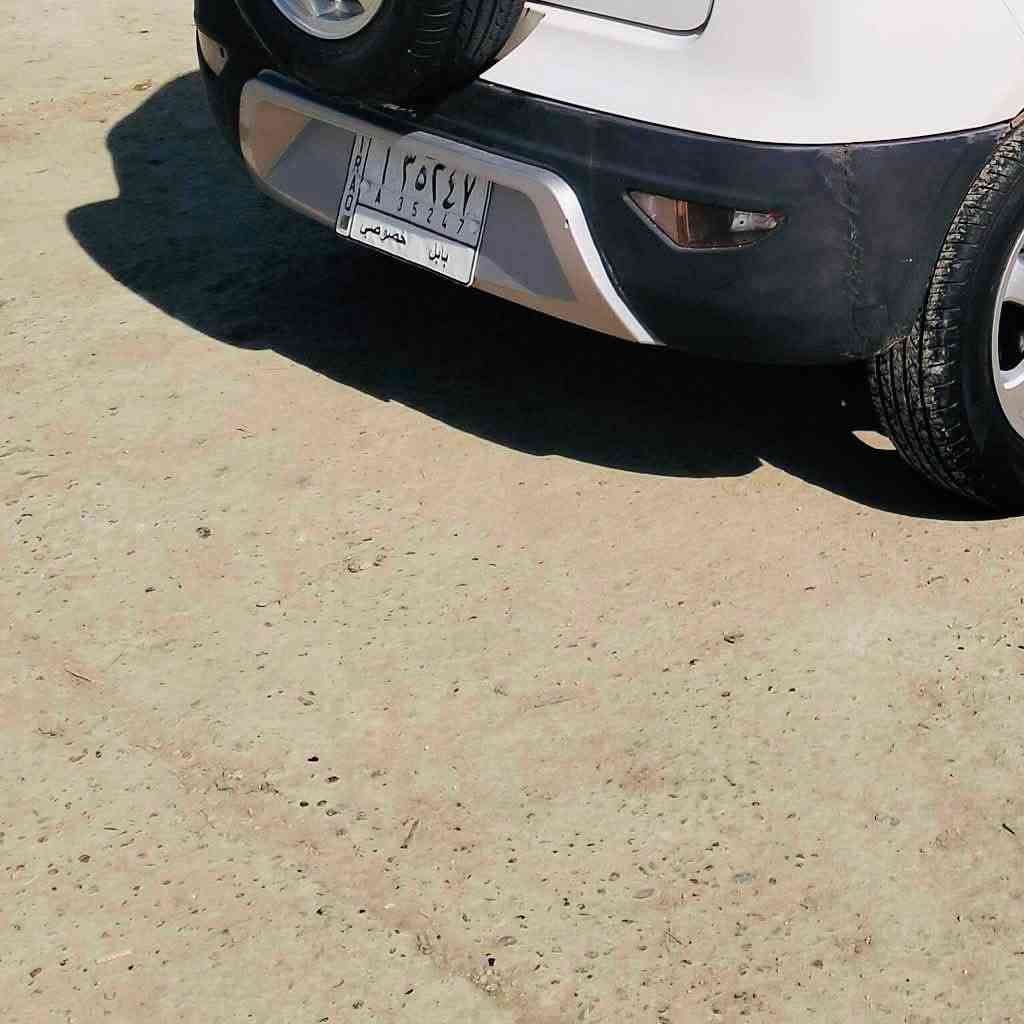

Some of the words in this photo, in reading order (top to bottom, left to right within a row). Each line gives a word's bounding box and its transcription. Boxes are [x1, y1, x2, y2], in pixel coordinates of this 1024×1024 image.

[344, 136, 364, 212] IRAQ
[359, 222, 408, 246] خصوصي
[427, 241, 449, 268] بابل
